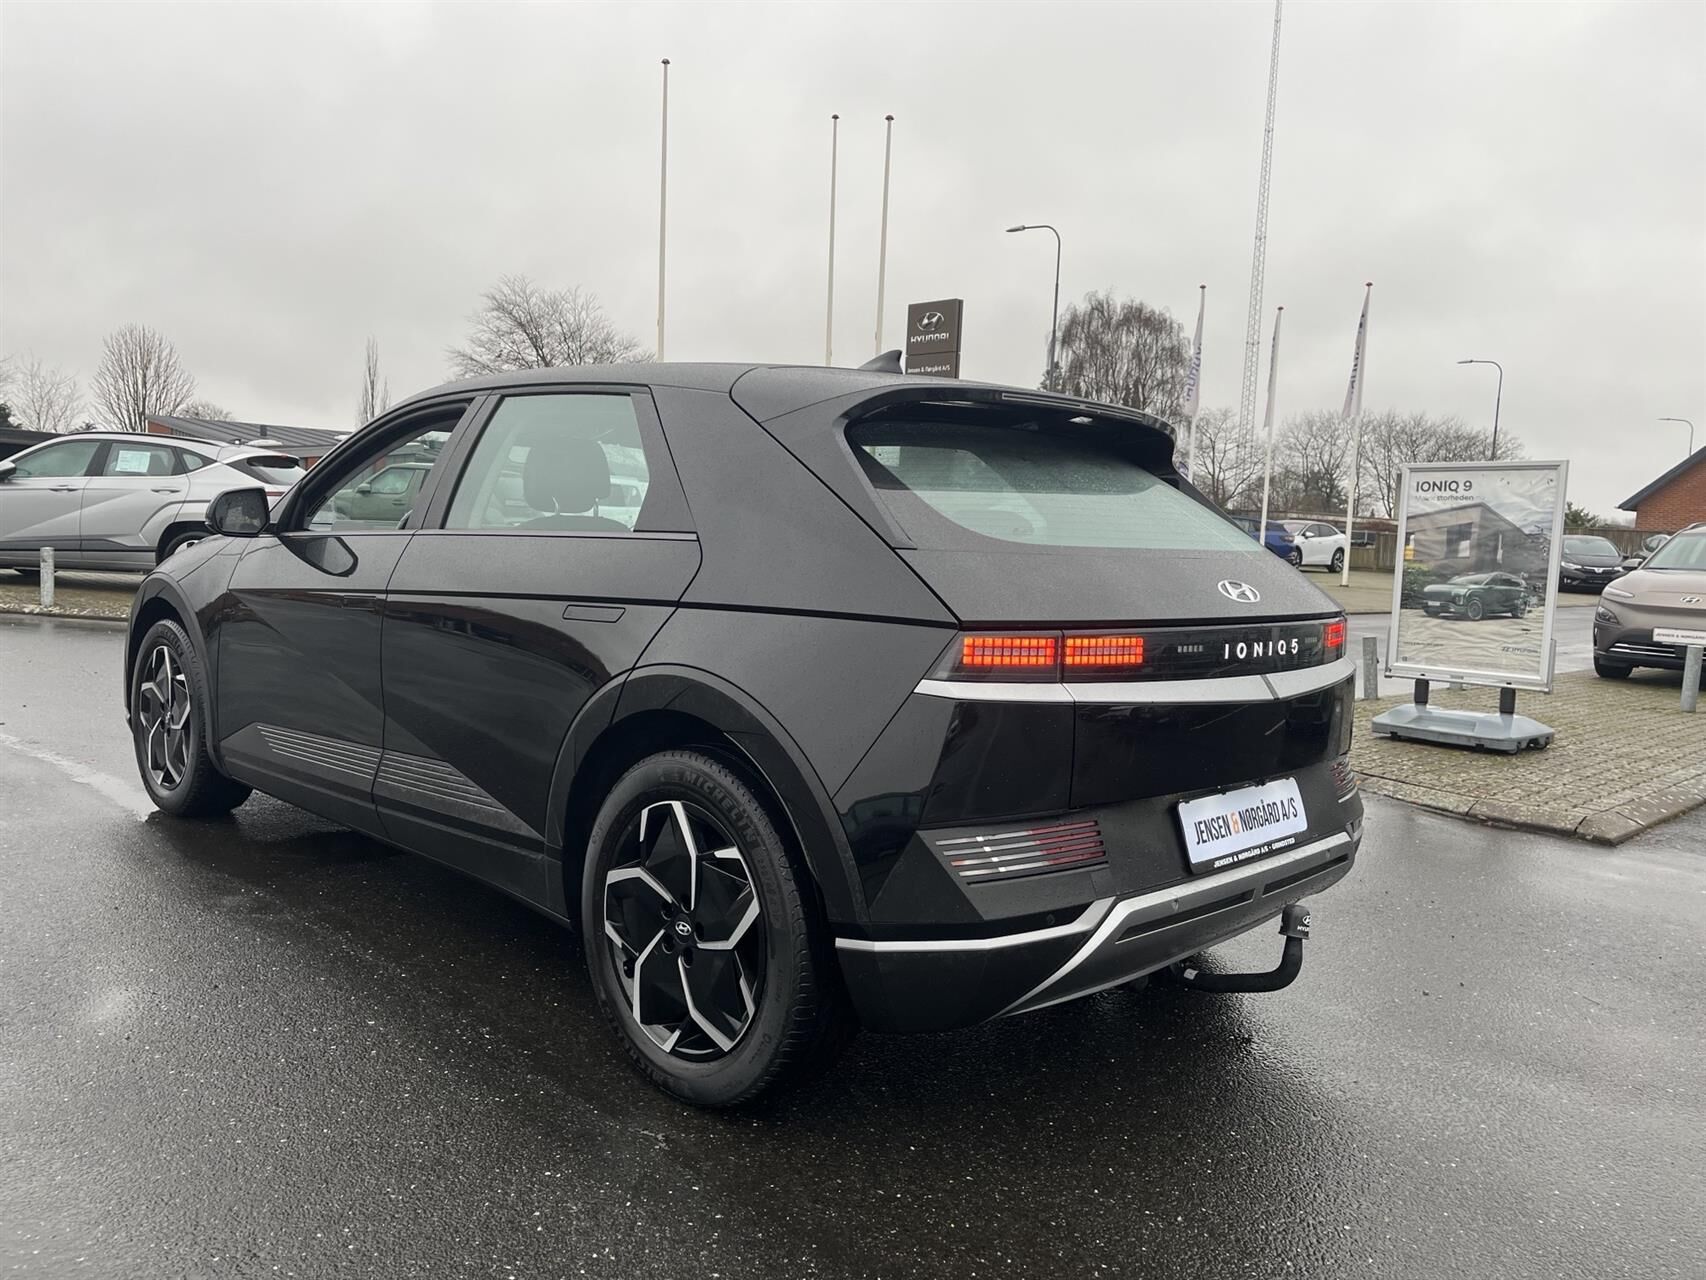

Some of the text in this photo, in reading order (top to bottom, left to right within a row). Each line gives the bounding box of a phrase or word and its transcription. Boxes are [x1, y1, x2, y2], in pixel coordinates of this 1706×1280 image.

[910, 332, 949, 344] HYUNDAI
[1416, 480, 1473, 493] IONIQ 9
[1193, 797, 1298, 845] JENSEN & NØRGÅRD A/S
[1214, 857, 1234, 869] JENSEN
